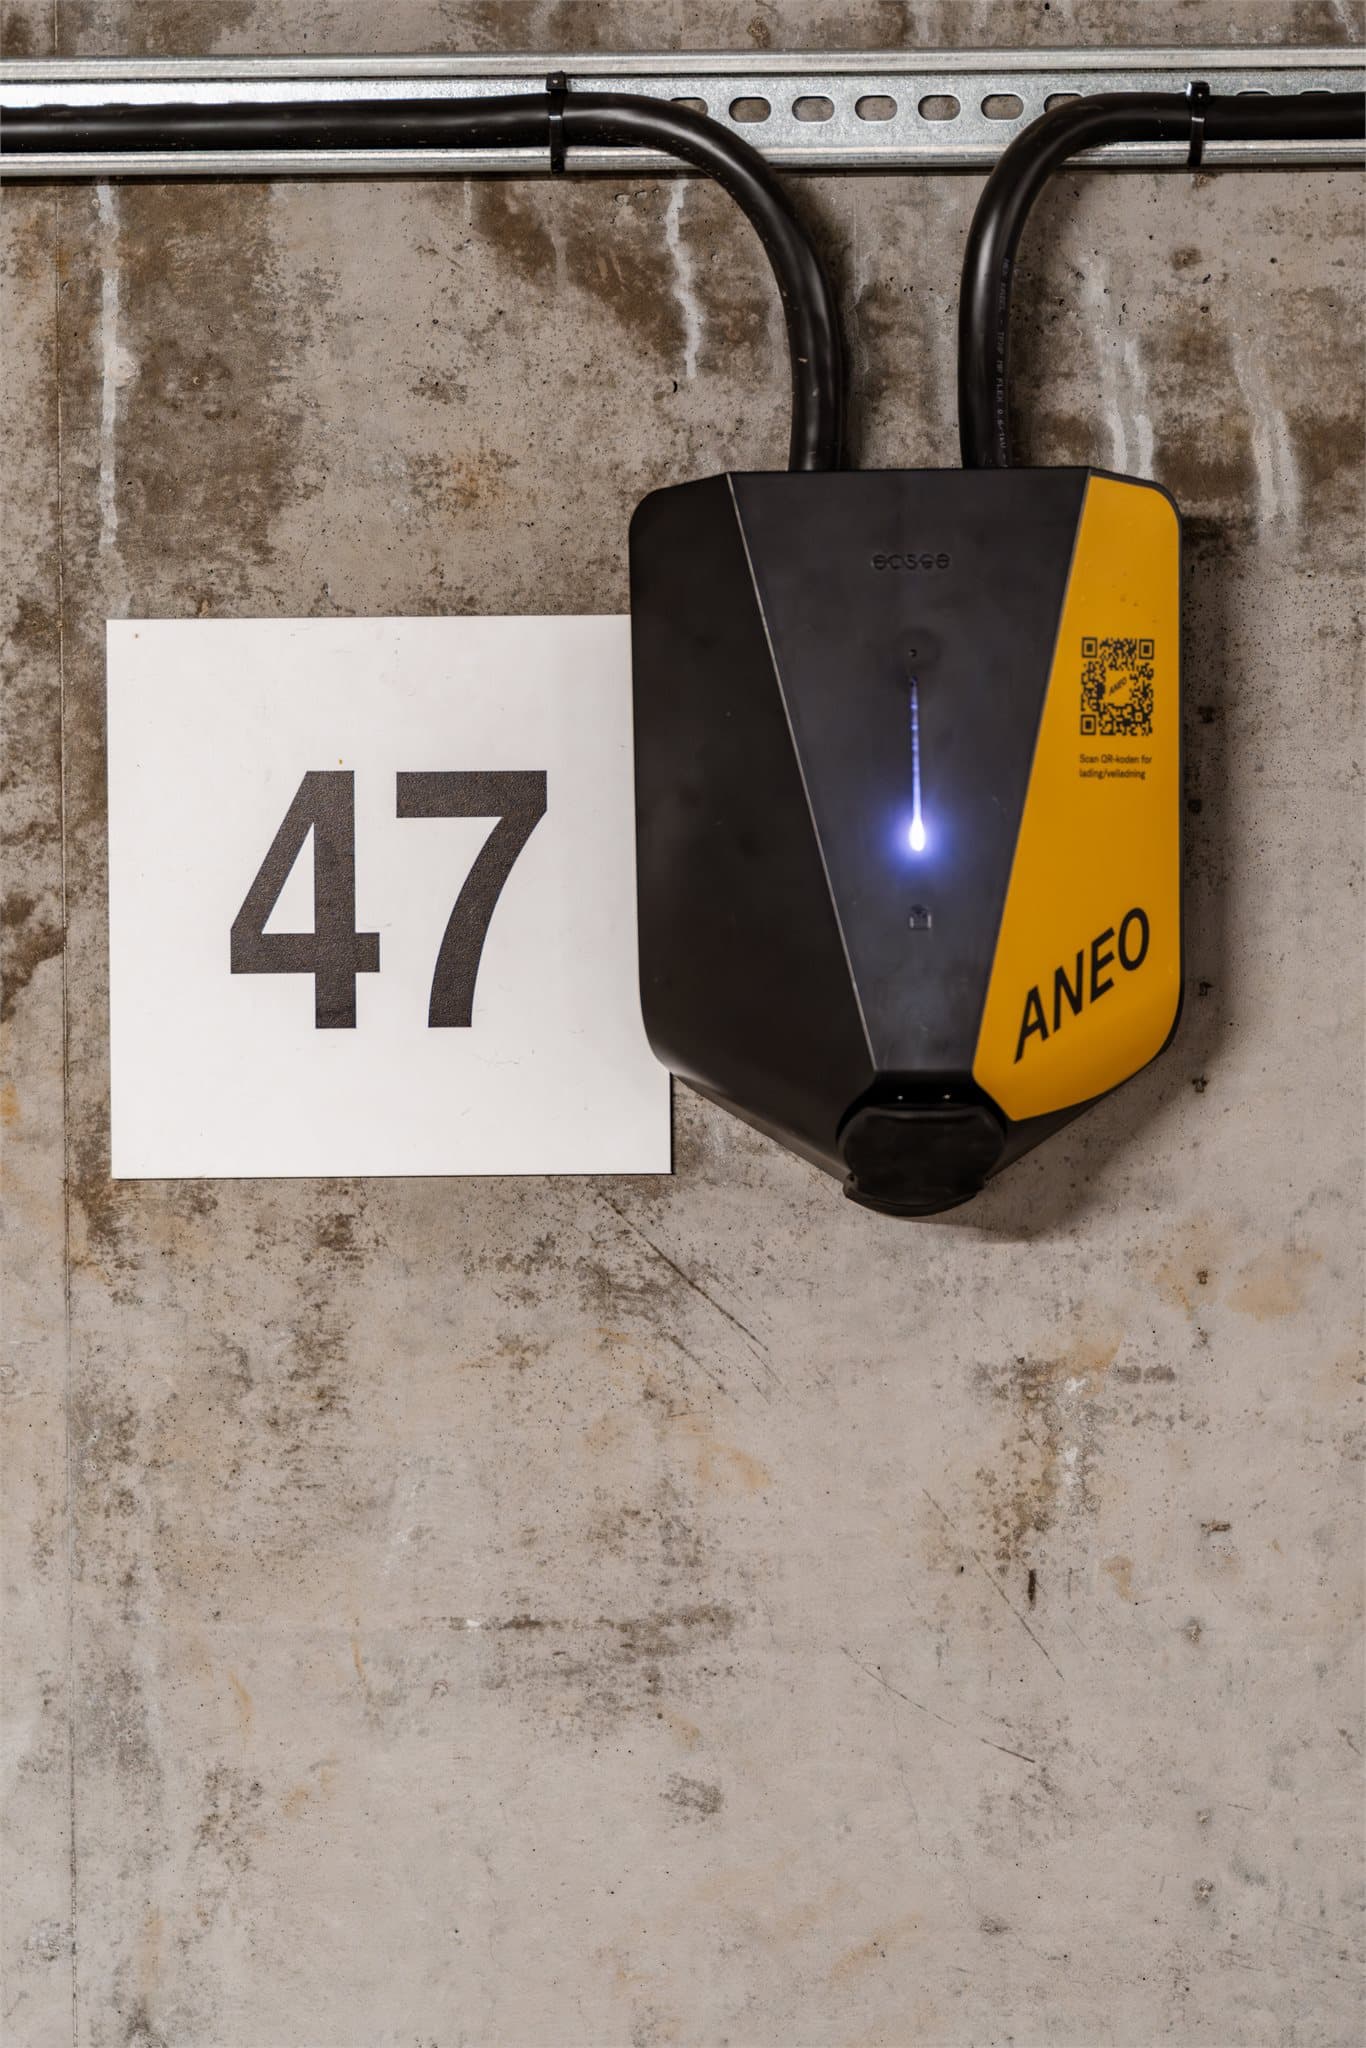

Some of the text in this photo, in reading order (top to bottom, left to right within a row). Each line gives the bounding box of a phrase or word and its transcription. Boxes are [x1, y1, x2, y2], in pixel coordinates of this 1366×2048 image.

[1079, 753, 1153, 764] Scan QR-koden for
[230, 770, 548, 1029] 47
[1013, 906, 1150, 1065] ANEO
